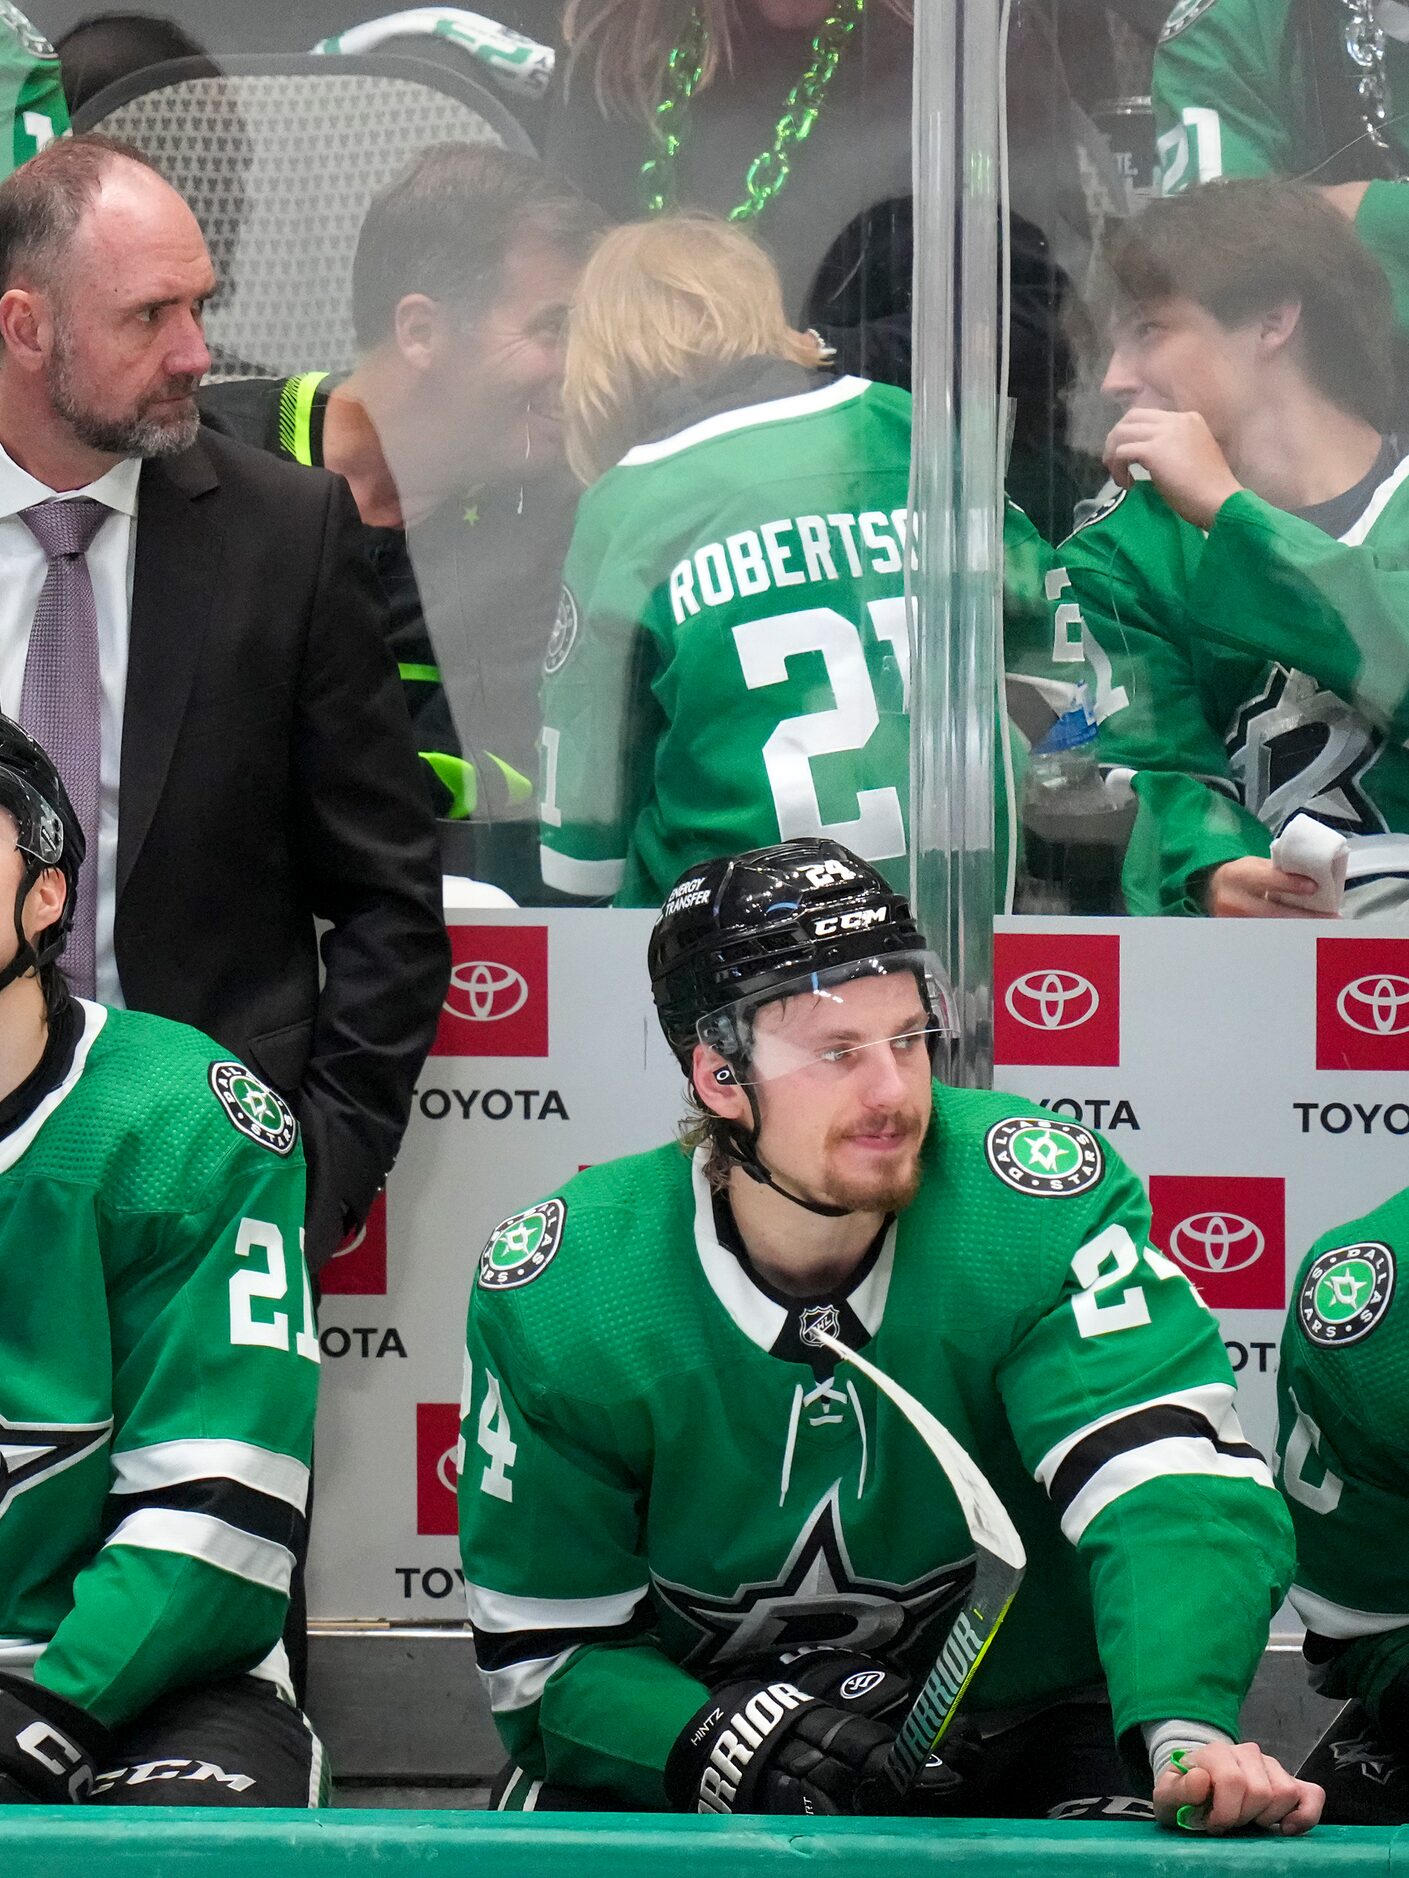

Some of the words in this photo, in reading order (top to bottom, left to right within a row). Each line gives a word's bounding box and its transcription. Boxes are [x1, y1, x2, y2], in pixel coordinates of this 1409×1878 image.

[541, 726, 562, 828] 1
[668, 877, 707, 903] ENERGY
[797, 859, 856, 889] 24
[665, 890, 712, 917] TRANSFER
[814, 906, 887, 936] CCM
[412, 1088, 570, 1121] OYOTA
[996, 1121, 1052, 1181] DALLAS
[1050, 1134, 1096, 1190] STARS
[1303, 1266, 1337, 1338] STARS
[1346, 1248, 1388, 1323] DALLAS
[690, 1706, 724, 1746] HINTZ
